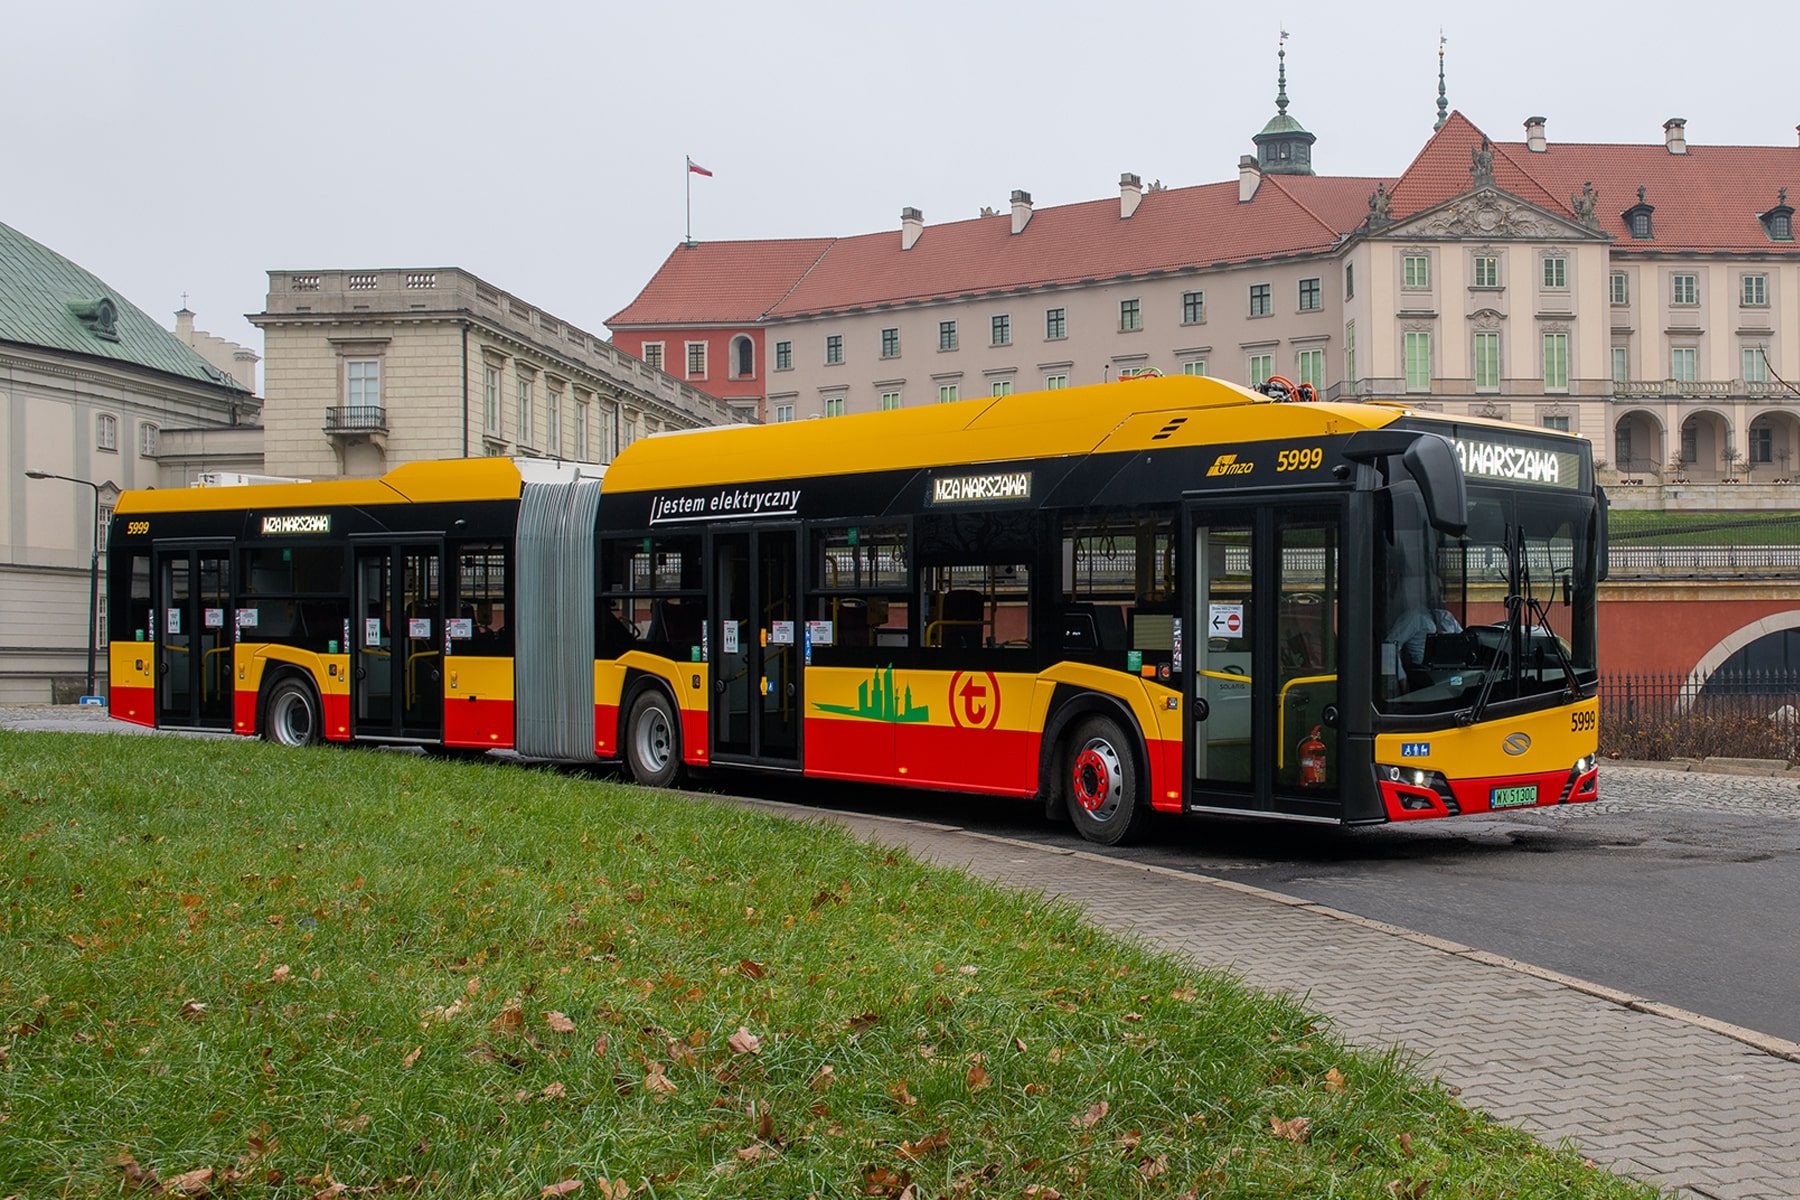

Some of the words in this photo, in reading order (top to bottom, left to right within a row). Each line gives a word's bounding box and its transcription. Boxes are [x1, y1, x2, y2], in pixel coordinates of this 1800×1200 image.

[1226, 462, 1254, 475] mza
[1276, 447, 1323, 472] 5999
[1469, 442, 1559, 483] WARSZAWA
[936, 479, 960, 500] MZA
[961, 474, 1027, 499] WARSZAWA
[656, 496, 705, 519] jestem
[710, 489, 801, 512] elektryczny
[127, 521, 150, 534] 5999
[282, 515, 329, 532] WARSZAWA
[1571, 710, 1596, 732] 5999
[1496, 789, 1508, 804] WX
